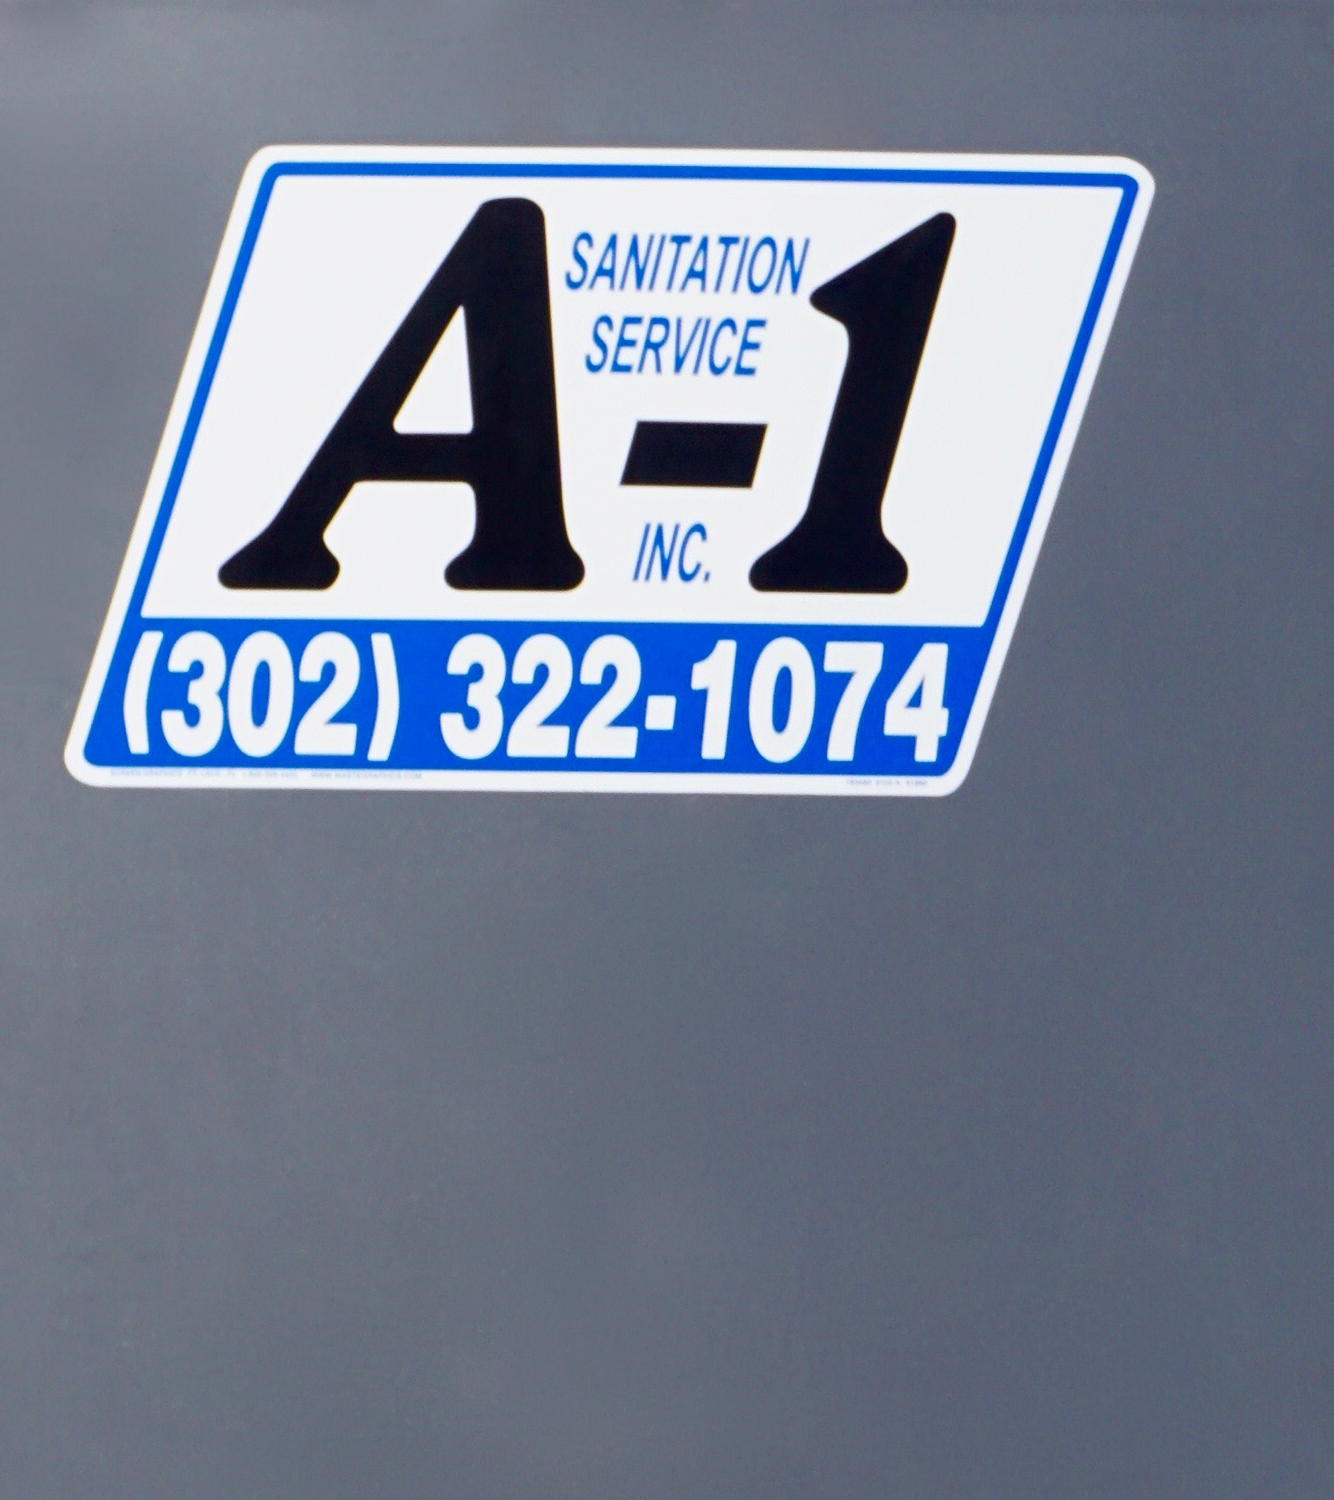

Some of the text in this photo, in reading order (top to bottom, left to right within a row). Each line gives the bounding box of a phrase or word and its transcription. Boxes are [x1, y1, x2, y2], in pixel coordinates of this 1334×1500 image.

[564, 231, 809, 295] SANITATION
[584, 313, 767, 377] SERVICE
[218, 197, 956, 594] A-1
[633, 521, 711, 583] INC.
[123, 630, 950, 763] (302) 322-1074
